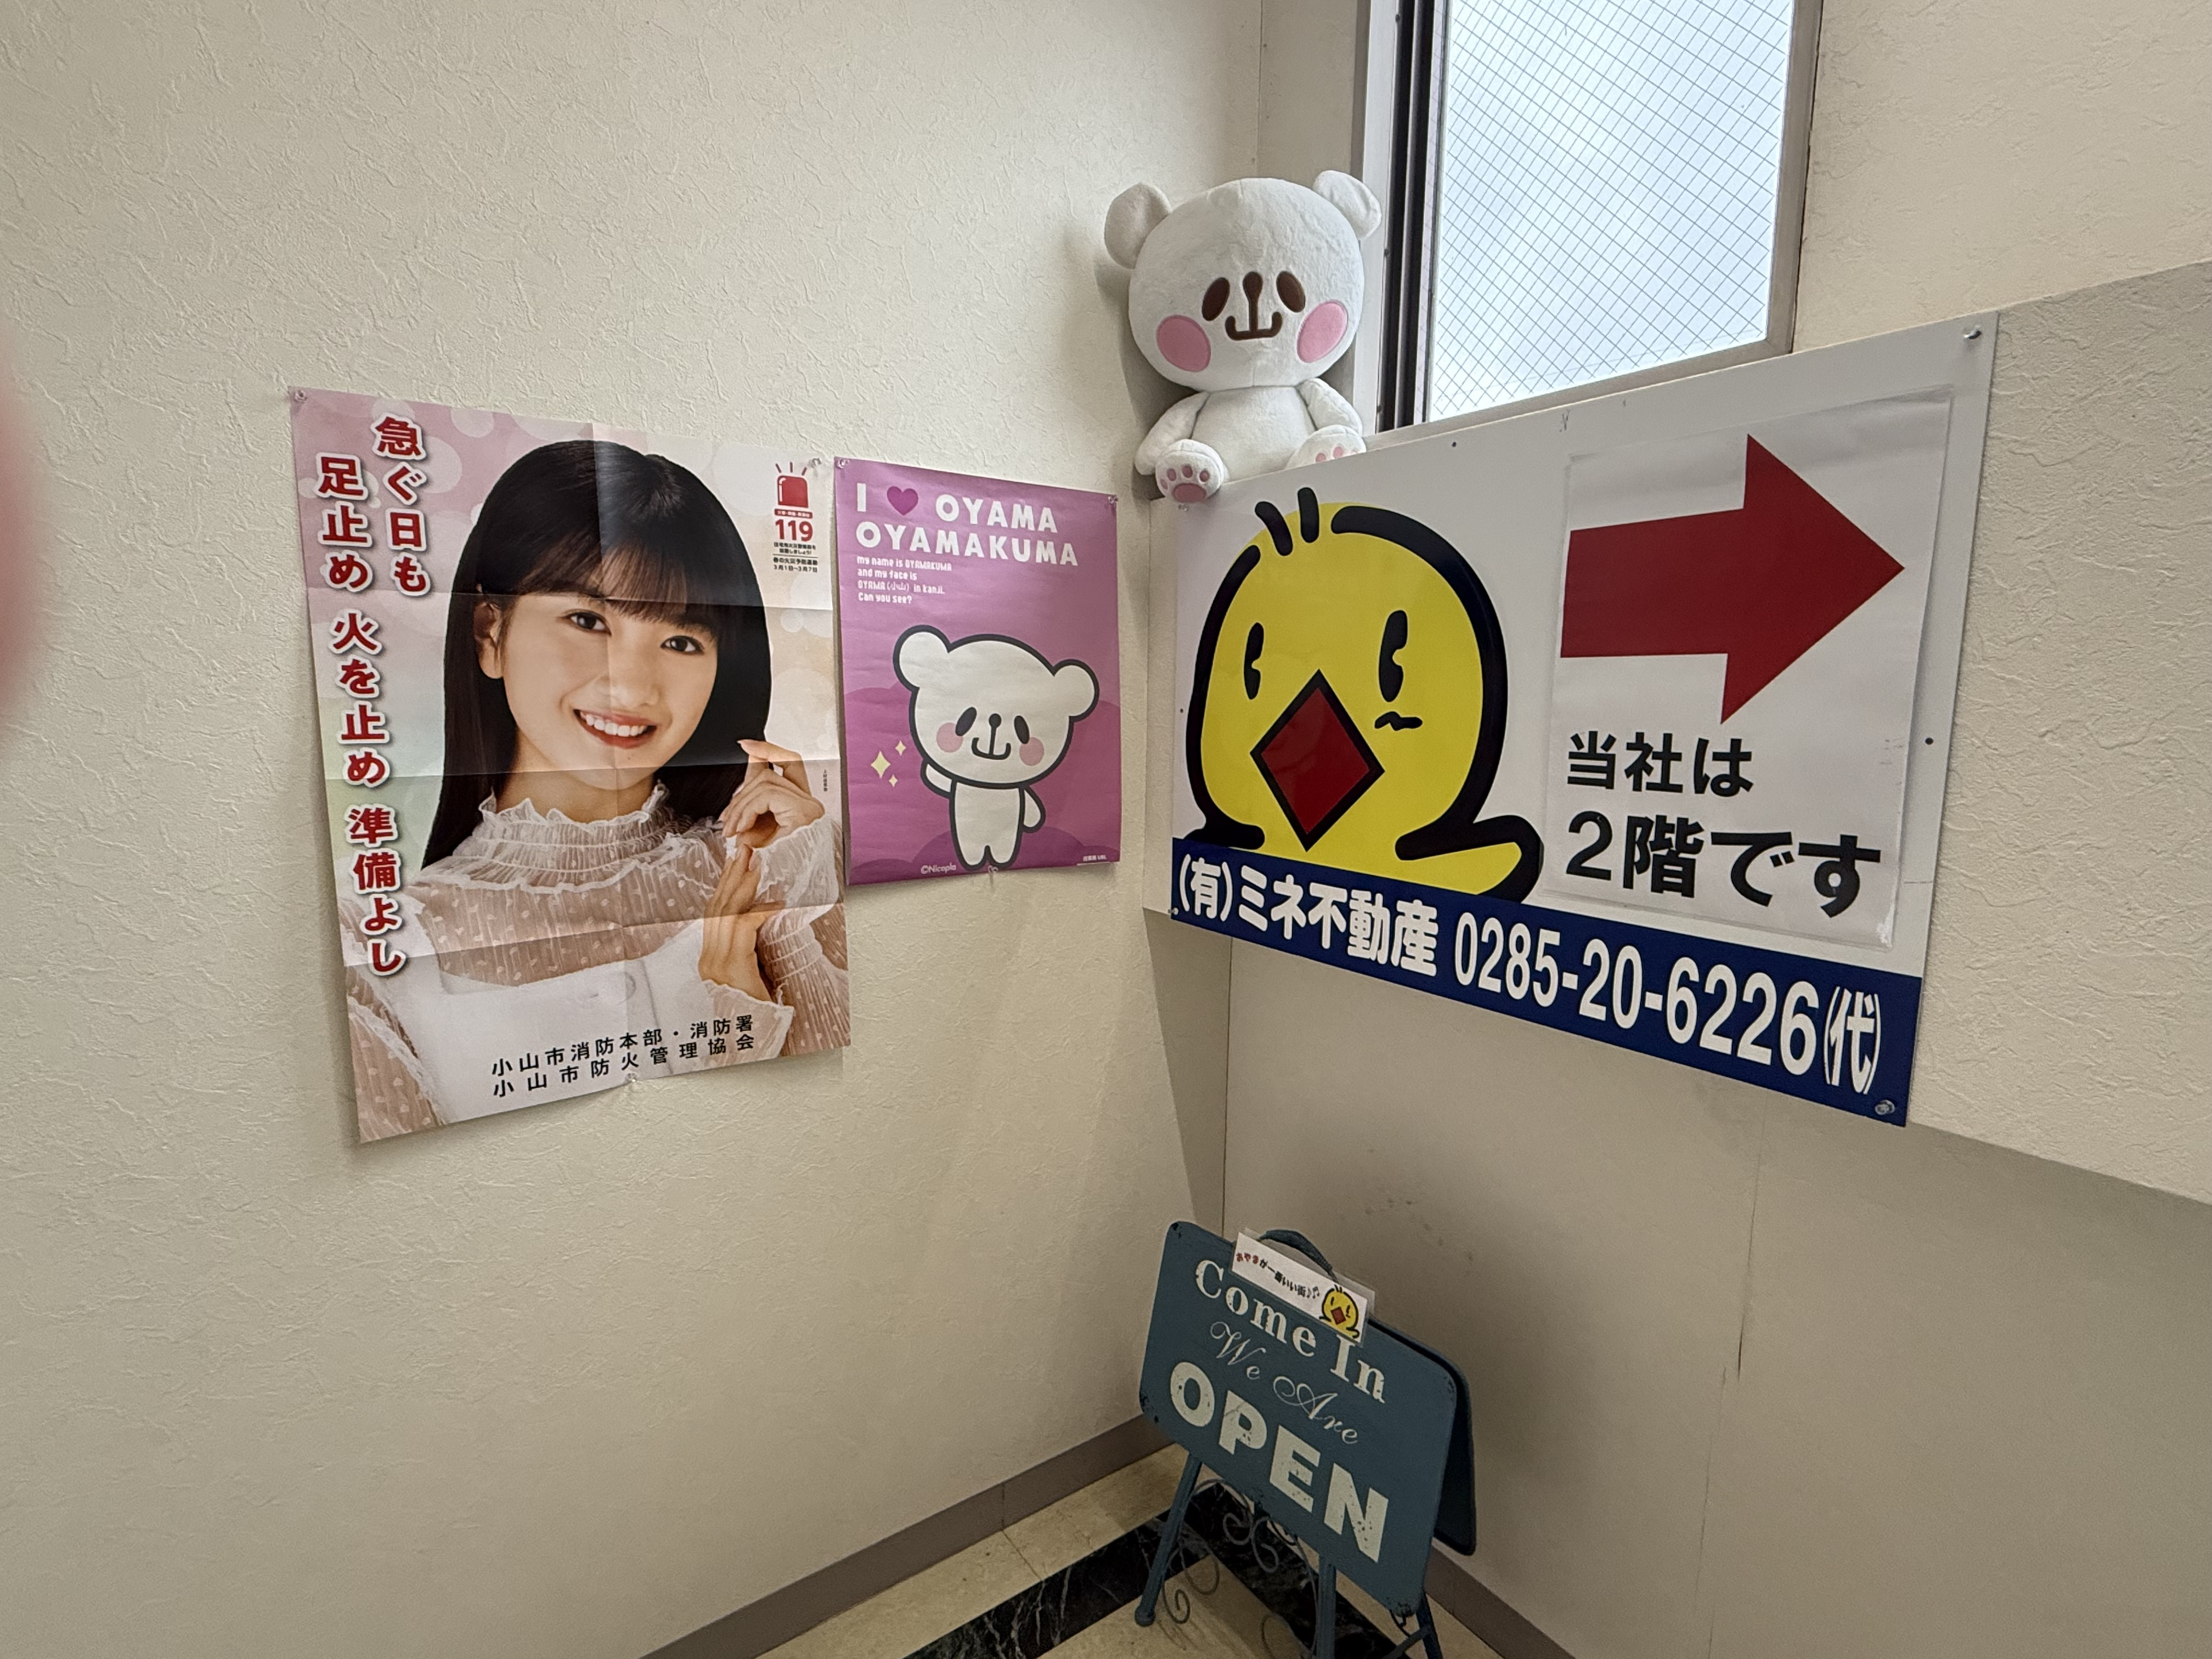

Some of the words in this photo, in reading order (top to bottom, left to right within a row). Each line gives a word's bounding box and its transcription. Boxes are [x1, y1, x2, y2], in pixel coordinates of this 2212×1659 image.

[317, 455, 370, 589] 足止め
[374, 415, 428, 593] 急ぐ日も
[775, 518, 814, 542] 119
[856, 482, 867, 512] I
[935, 494, 1058, 534] OYAMA
[855, 521, 1079, 567] OYAMAKUMA
[857, 568, 872, 577] and
[874, 569, 888, 578] my
[889, 570, 908, 580] face
[910, 572, 917, 580] is
[871, 557, 894, 566] name
[895, 558, 903, 567] is
[905, 559, 952, 571] OYAMAKUMA
[858, 592, 874, 601] Can
[876, 594, 891, 603] you
[892, 595, 912, 604] see?
[913, 584, 922, 592] in
[331, 611, 386, 785] 火を止め
[1567, 730, 1753, 797] 当社は
[346, 805, 403, 974] 準備よし
[1566, 810, 1881, 918] 2階です
[1179, 853, 1439, 977] (有)ミネ不動産
[492, 1014, 754, 1077] 小山市消防本部・消防署
[493, 1033, 755, 1098] 小山市防火管理協会
[1194, 1259, 1317, 1358] Come
[1330, 1334, 1386, 1404] In
[1210, 1321, 1266, 1380] We
[1273, 1375, 1359, 1445] Are
[1169, 1361, 1389, 1563] OPEN
